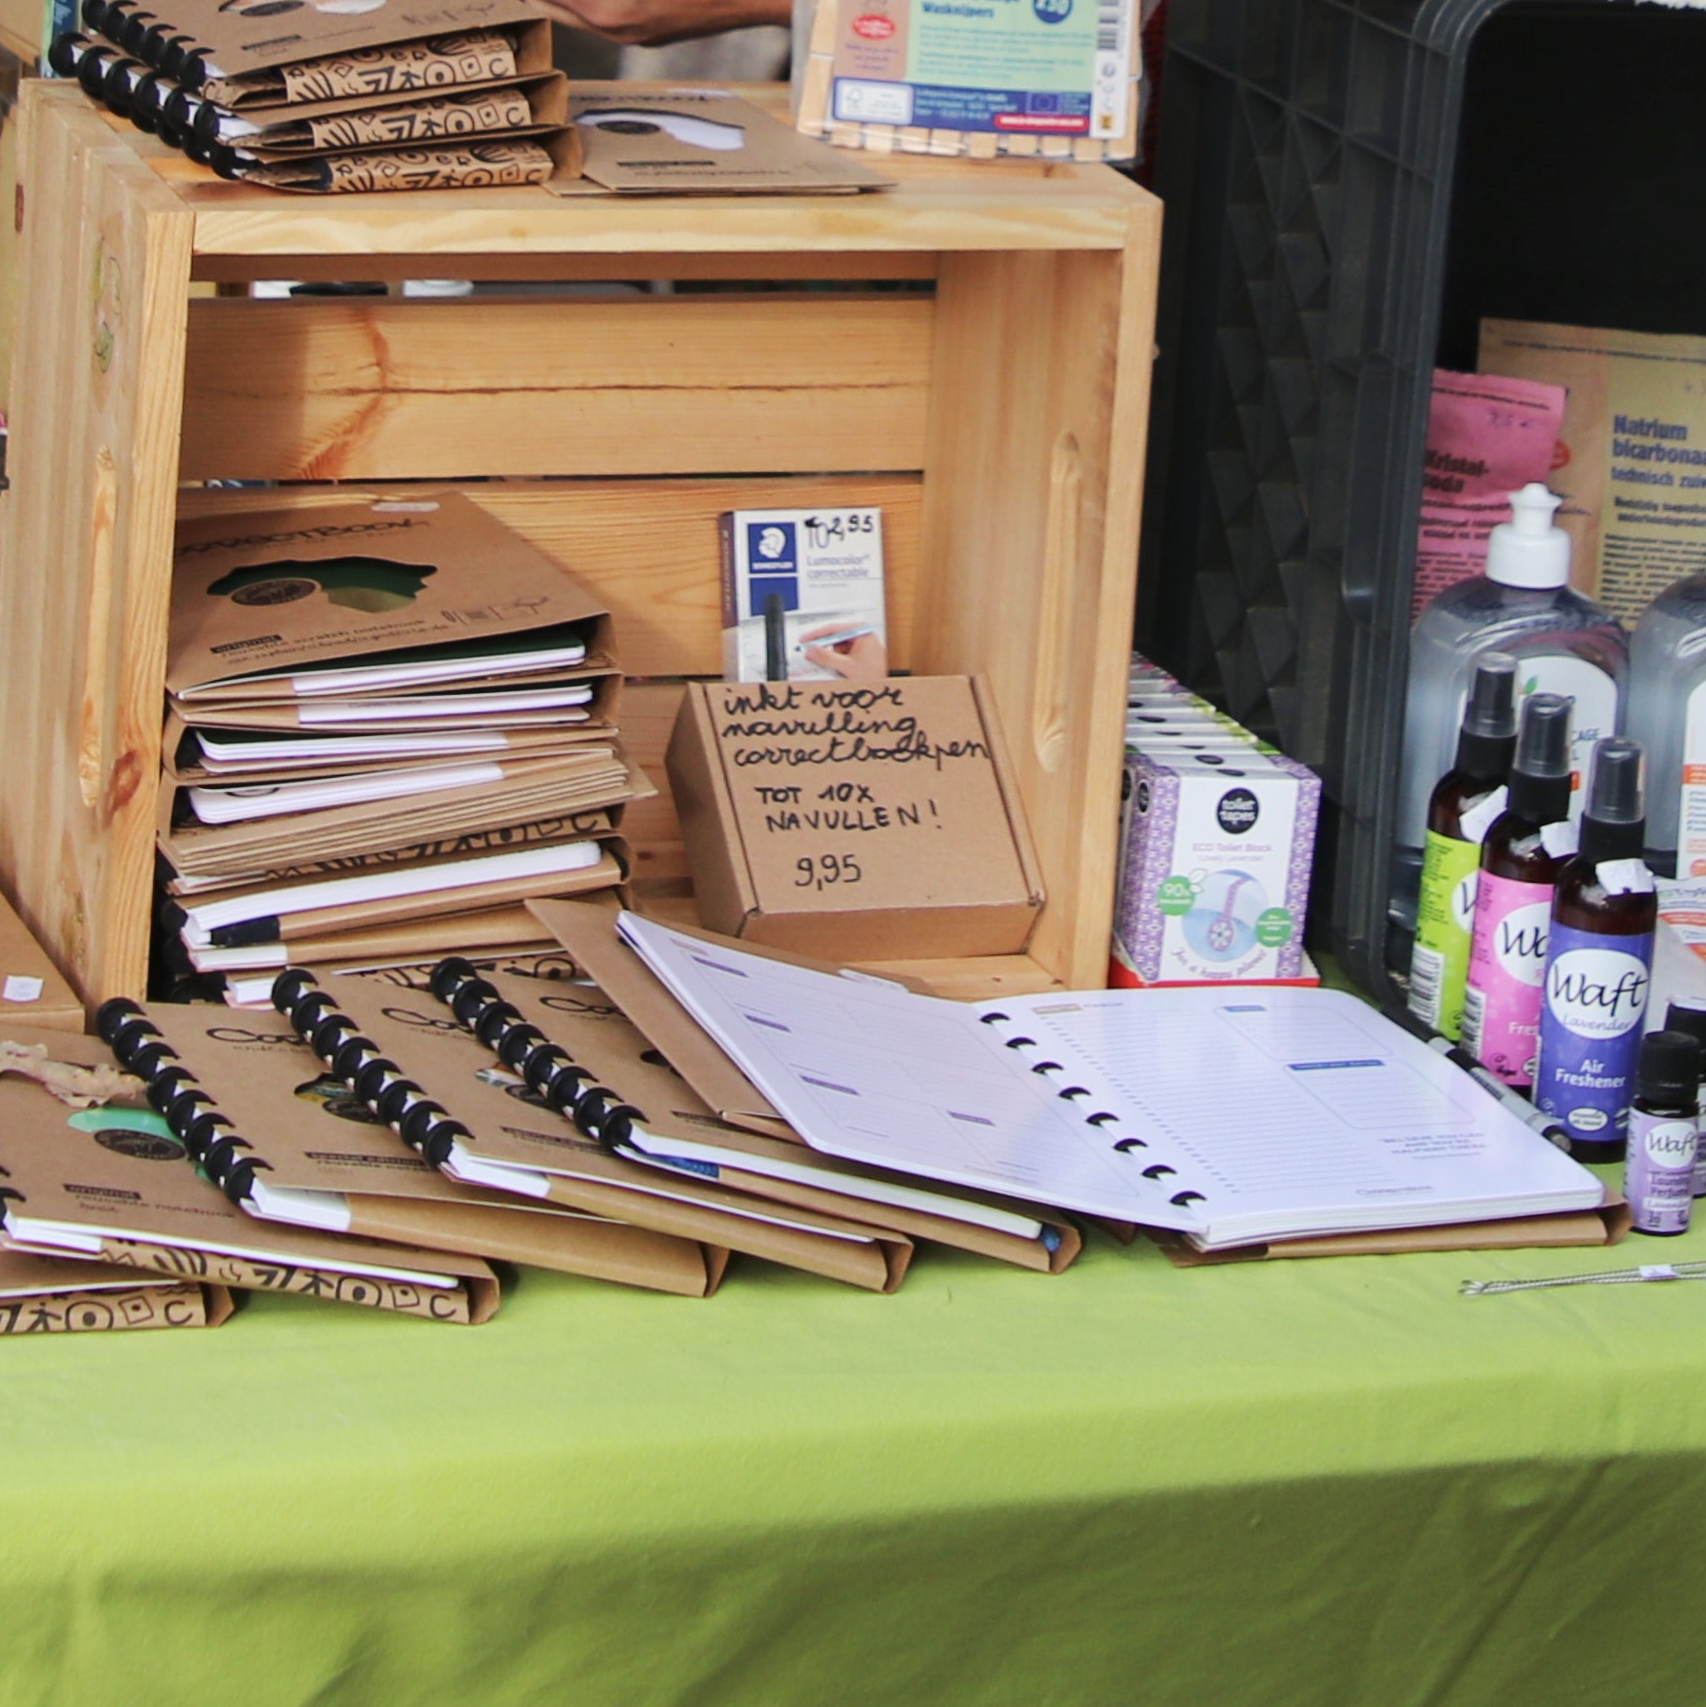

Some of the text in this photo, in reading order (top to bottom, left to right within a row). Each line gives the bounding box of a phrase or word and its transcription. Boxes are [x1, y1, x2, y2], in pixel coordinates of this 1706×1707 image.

[922, 1, 996, 19] Wasknijpers
[1613, 414, 1687, 441] Natrium
[1611, 466, 1674, 489] technisch
[807, 568, 869, 579] correctable
[724, 682, 905, 715] inkt voor
[722, 709, 917, 739] navulling
[754, 785, 804, 805] TOT
[1221, 798, 1254, 811] toilet
[1220, 810, 1255, 825] tapes
[1193, 843, 1271, 852] ECO Toilet Block
[795, 854, 862, 891] 9,95
[1553, 962, 1647, 1018] Waft
[1562, 1011, 1632, 1032] Lavender
[1579, 1058, 1605, 1074] Air
[1554, 1067, 1627, 1090] Freshener
